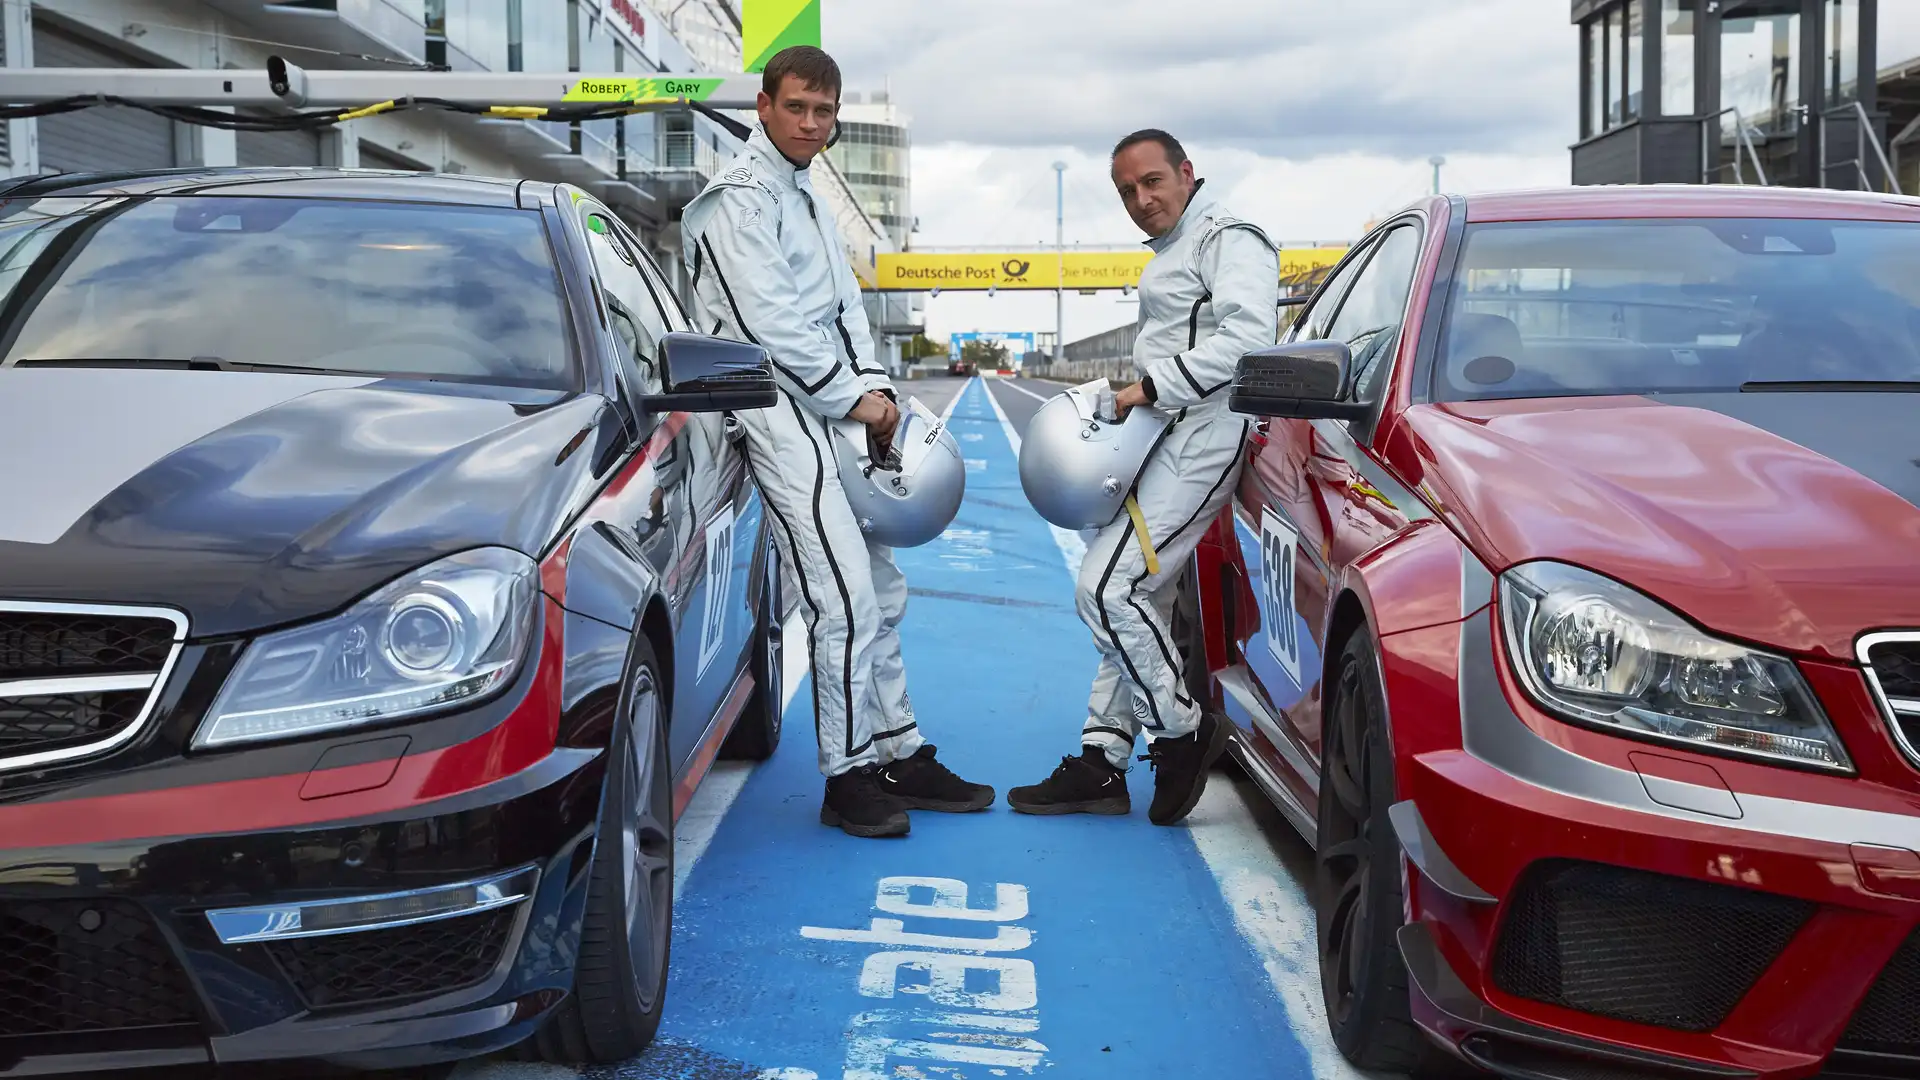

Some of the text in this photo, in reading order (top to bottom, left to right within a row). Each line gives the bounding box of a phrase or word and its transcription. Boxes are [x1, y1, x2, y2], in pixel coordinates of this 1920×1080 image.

[581, 81, 700, 93] ROBERT GARY
[896, 265, 996, 279] Deutsche Post
[1083, 266, 1108, 277] Post
[1113, 265, 1129, 277] für
[704, 523, 731, 656] 127
[1263, 527, 1297, 664] 538
